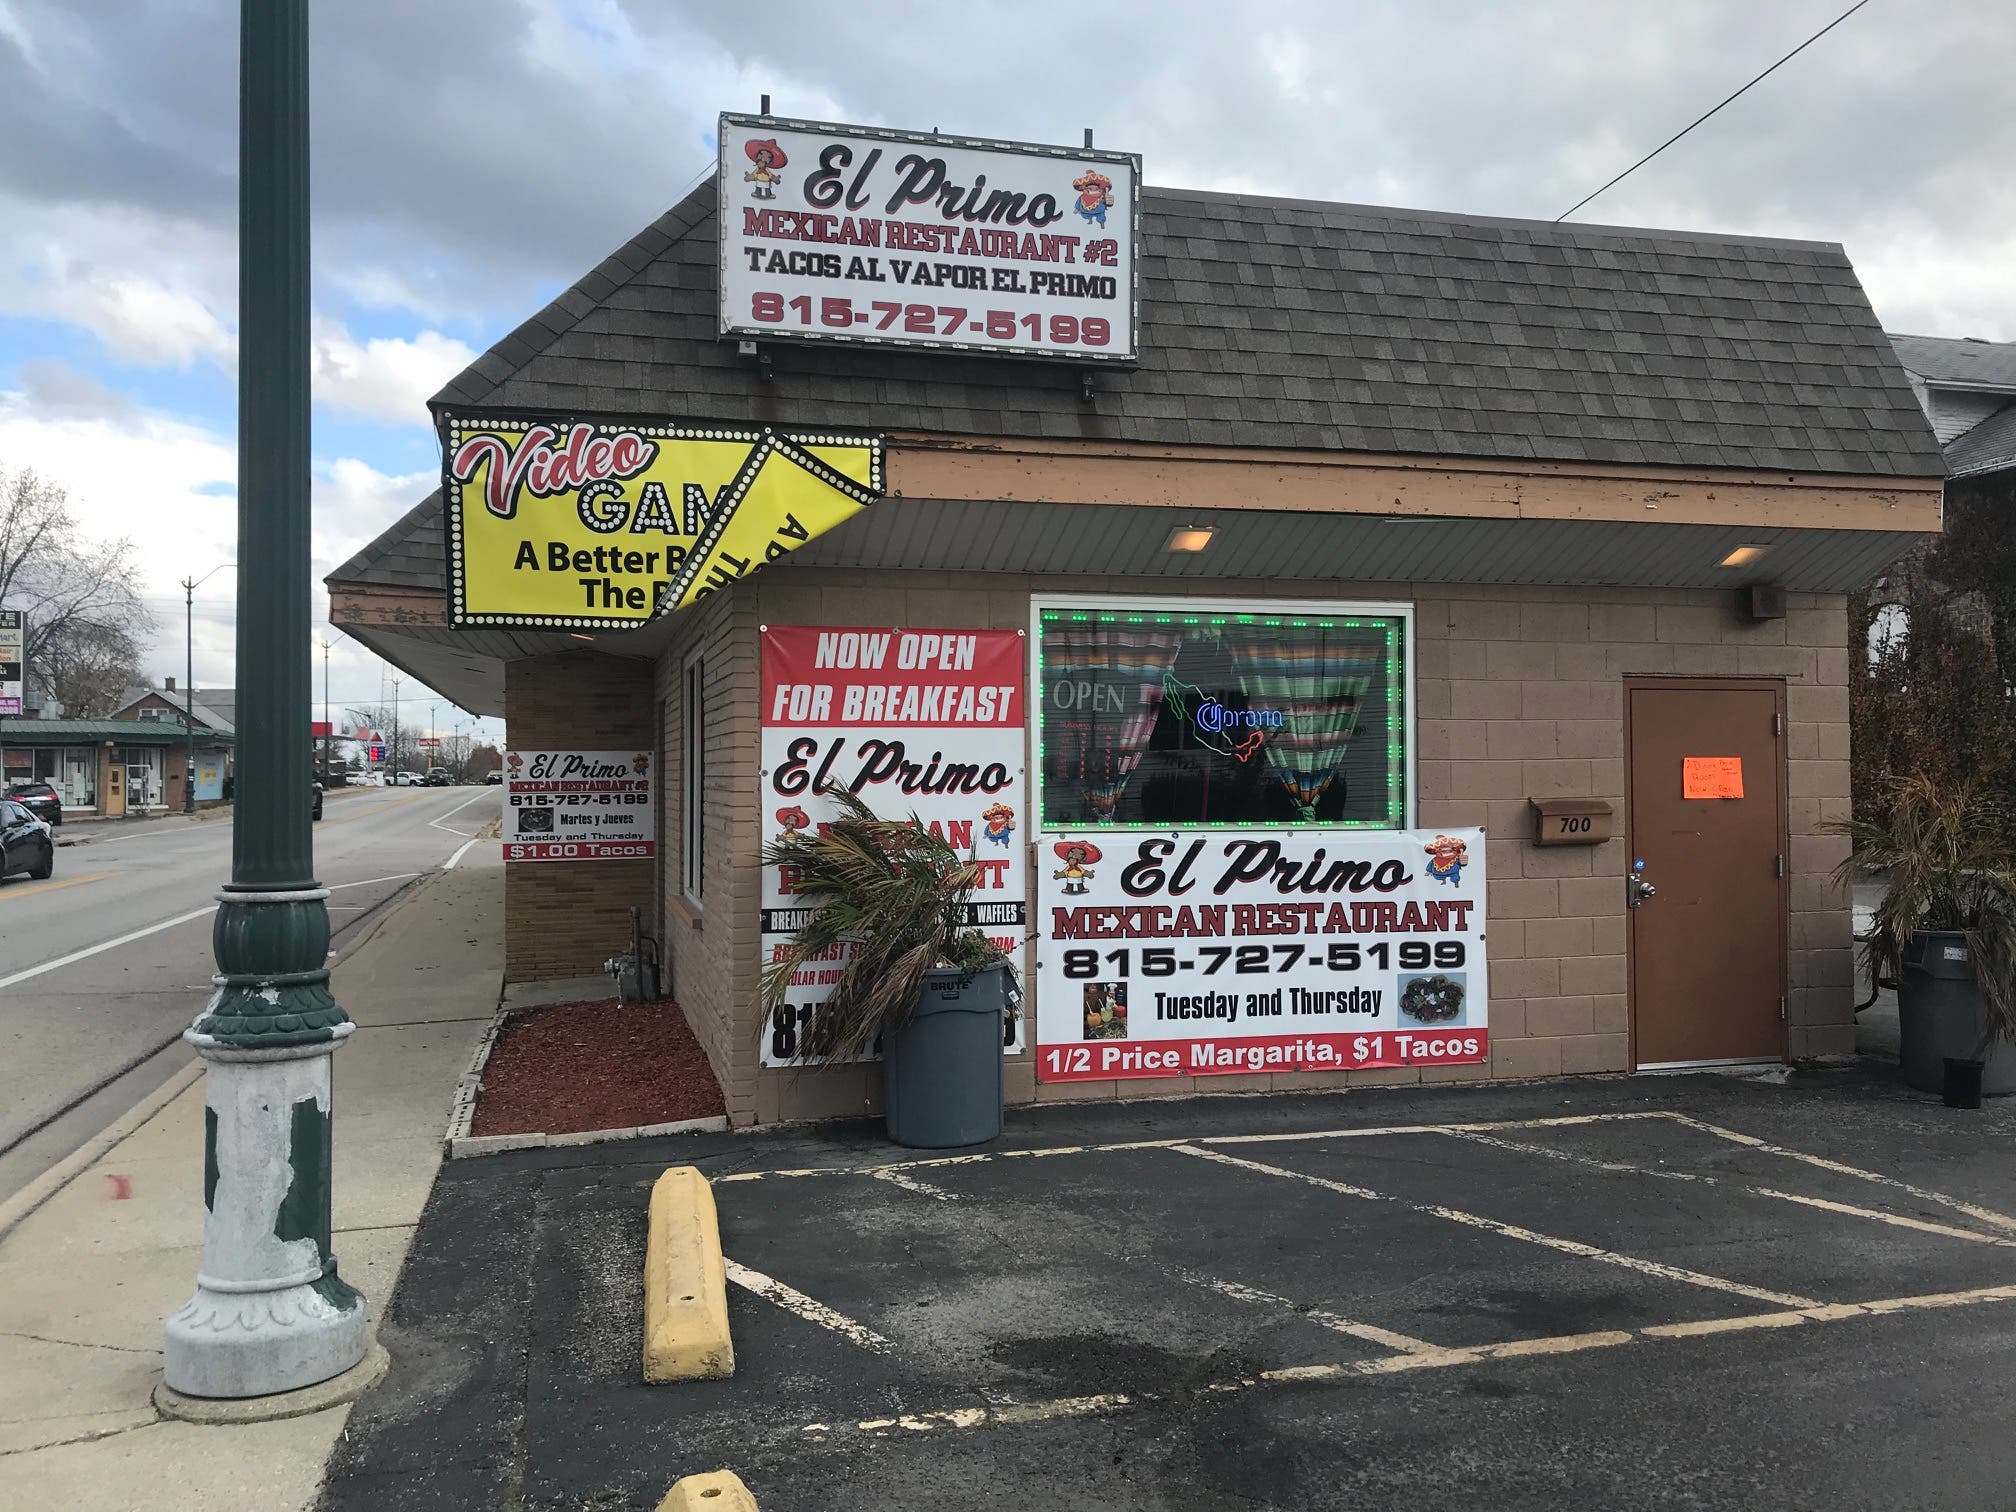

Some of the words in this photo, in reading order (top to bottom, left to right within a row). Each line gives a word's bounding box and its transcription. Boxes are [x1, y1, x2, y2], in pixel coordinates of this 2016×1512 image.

[803, 144, 882, 211] El
[885, 154, 1063, 228] Primo
[743, 207, 887, 248] MEXICAN
[886, 221, 1081, 264] RESTAURANT
[1083, 239, 1118, 266] #2
[744, 246, 841, 279] TACOS
[844, 256, 886, 282] AL
[889, 259, 989, 291] VAPOR
[990, 269, 1026, 294] EL
[1030, 271, 1116, 300] PRIMO
[751, 291, 1111, 346] 815-727-5199
[453, 422, 654, 516] Video
[577, 480, 731, 536] GAM
[514, 540, 540, 571] A
[548, 542, 659, 574] Better
[579, 578, 646, 610] The
[814, 633, 890, 670] NOW
[897, 634, 976, 670] OPEN
[772, 684, 833, 721] FOR
[841, 685, 1015, 722] BREAKFAST
[1053, 680, 1126, 713] OPEN
[1197, 702, 1283, 732] Corona
[529, 753, 559, 779] El
[560, 754, 629, 779] Primo
[772, 737, 846, 797] El
[850, 739, 1013, 796] Primo
[510, 793, 649, 806] 815-727-5199
[514, 833, 562, 842] Tuesday
[566, 833, 587, 841] and
[590, 832, 644, 841] Thursday
[560, 814, 592, 825] Martes
[594, 816, 600, 826] y
[602, 813, 634, 825] Jueves
[1560, 817, 1591, 832] 700
[510, 844, 578, 859] $1.00
[586, 844, 647, 857] Tacos
[1120, 839, 1207, 898] El
[1213, 838, 1414, 897] Primo
[977, 904, 1018, 923] WAFFLES
[1052, 904, 1229, 940] MEXICAN
[1232, 900, 1474, 936] RESTAURANT
[1062, 941, 1466, 979] 815-727-5199
[930, 981, 969, 991] BRUTE
[1155, 992, 1238, 1022] Tuesday
[1246, 990, 1280, 1016] and
[1287, 986, 1382, 1018] Thursday
[1046, 1048, 1091, 1073] 1/2
[1102, 1046, 1180, 1070] Price
[1191, 1038, 1343, 1069] Margarita,
[1353, 1035, 1384, 1062] $1
[1395, 1034, 1479, 1058] Tacos
